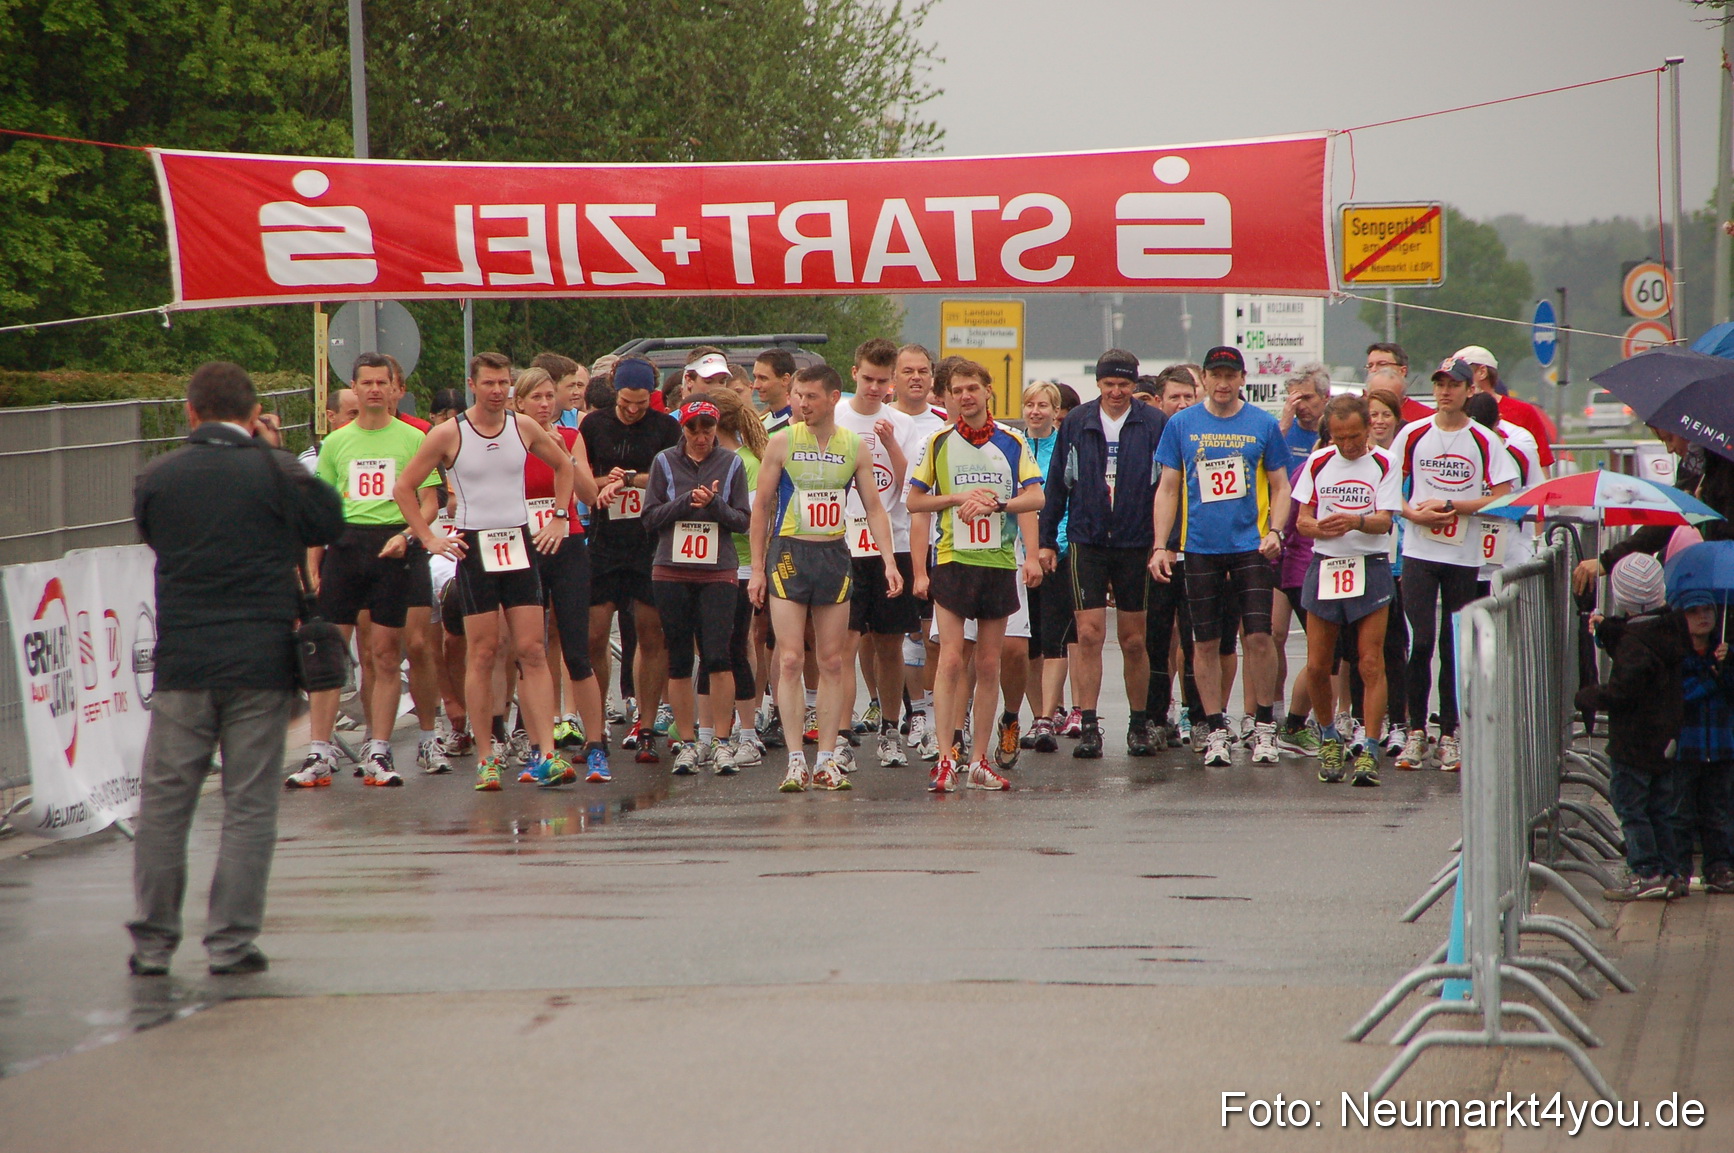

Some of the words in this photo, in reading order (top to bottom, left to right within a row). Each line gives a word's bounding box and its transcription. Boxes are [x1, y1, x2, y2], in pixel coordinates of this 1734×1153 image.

[1637, 279, 1664, 303] 60
[1246, 330, 1265, 350] SHB
[1199, 440, 1246, 448] STADTLAUF
[1203, 433, 1257, 443] NEUMARKTER
[792, 450, 846, 464] BOCK
[1420, 459, 1465, 469] GERHART
[955, 473, 1003, 485] BOCK
[956, 464, 987, 473] TEAM
[1440, 469, 1470, 478] JANIG
[358, 472, 385, 496] 68
[1211, 470, 1237, 496] 32
[1320, 486, 1366, 495] GERHART
[617, 489, 641, 514] 73
[1339, 495, 1371, 503] JANIG
[808, 503, 840, 527] 100
[968, 518, 990, 543] 10
[493, 542, 511, 566] 11
[681, 535, 708, 559] 40
[1483, 534, 1496, 558] 9
[1332, 569, 1354, 593] 18
